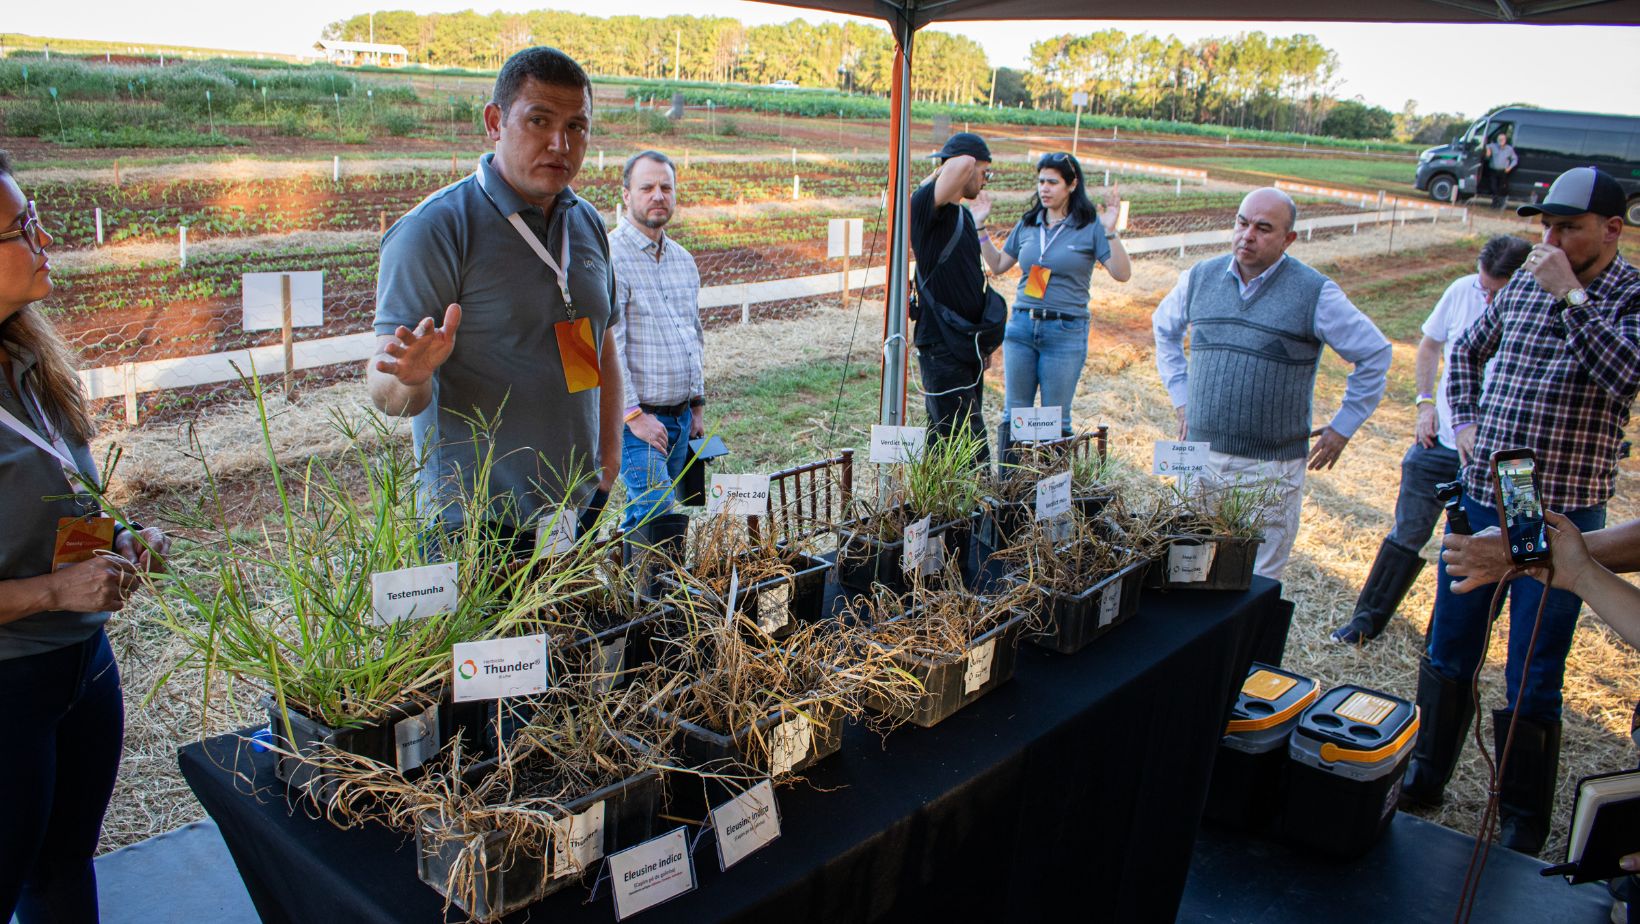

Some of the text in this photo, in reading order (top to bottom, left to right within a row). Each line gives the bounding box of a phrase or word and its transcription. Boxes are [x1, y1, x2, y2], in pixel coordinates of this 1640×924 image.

[726, 490, 766, 499] Select 240
[387, 585, 444, 600] Testemunha
[725, 817, 751, 836] Eleusine
[624, 853, 682, 882] Eleusine indica
